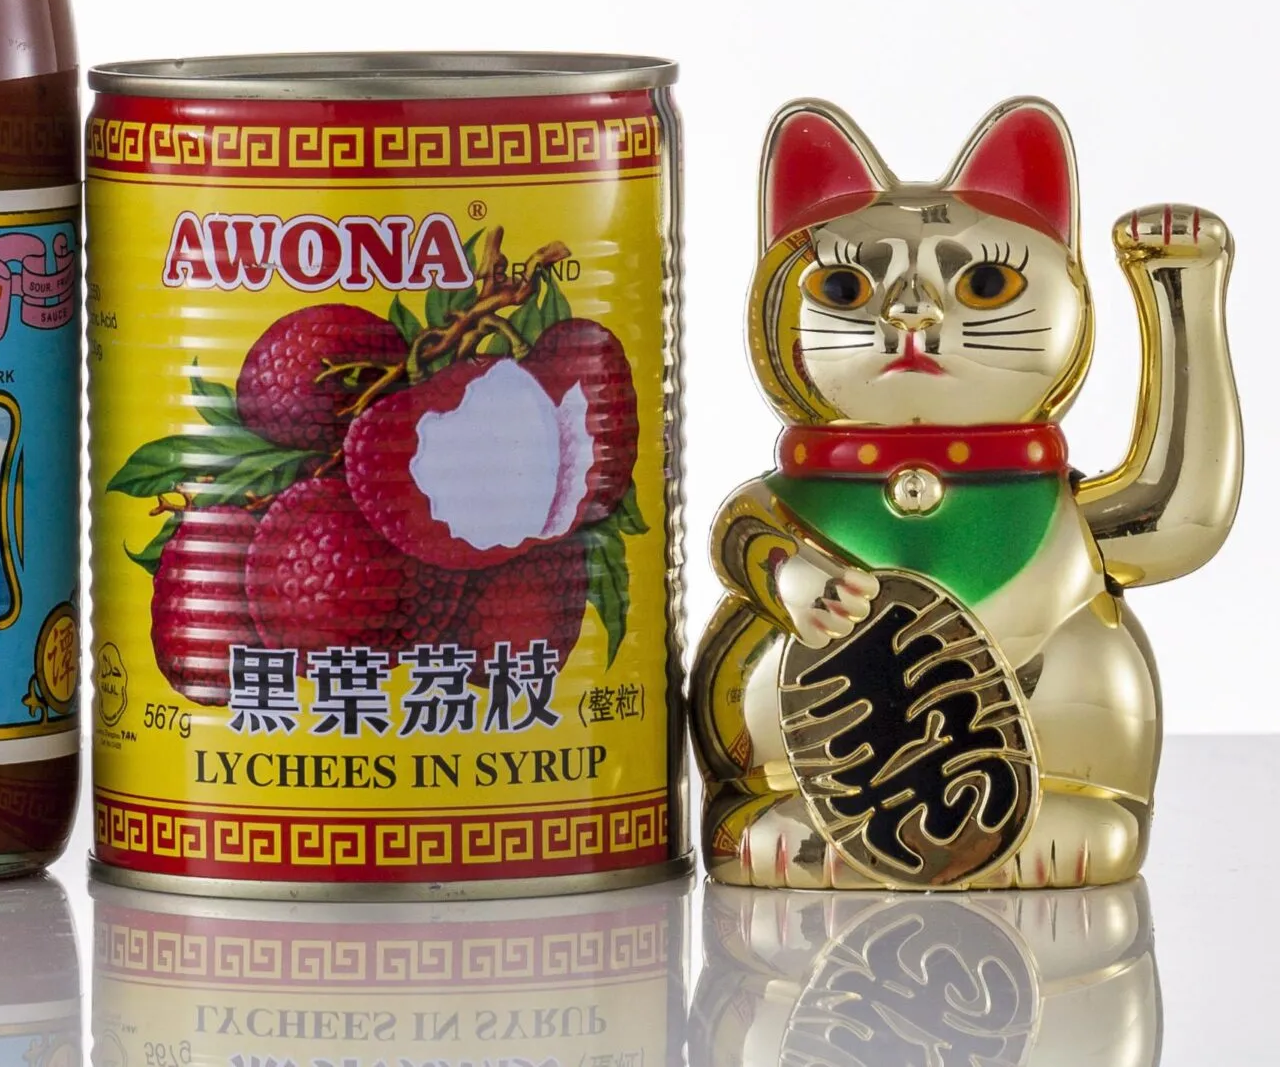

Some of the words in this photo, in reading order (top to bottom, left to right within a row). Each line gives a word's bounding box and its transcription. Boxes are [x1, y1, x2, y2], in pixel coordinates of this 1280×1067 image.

[162, 210, 474, 291] AWONA
[493, 259, 582, 283] BRAND
[228, 638, 564, 739] 黑葉荔枝
[144, 703, 192, 739] 567g
[194, 749, 397, 789] LYCHEES
[411, 754, 462, 789] IN
[473, 745, 608, 787] SYRUP
